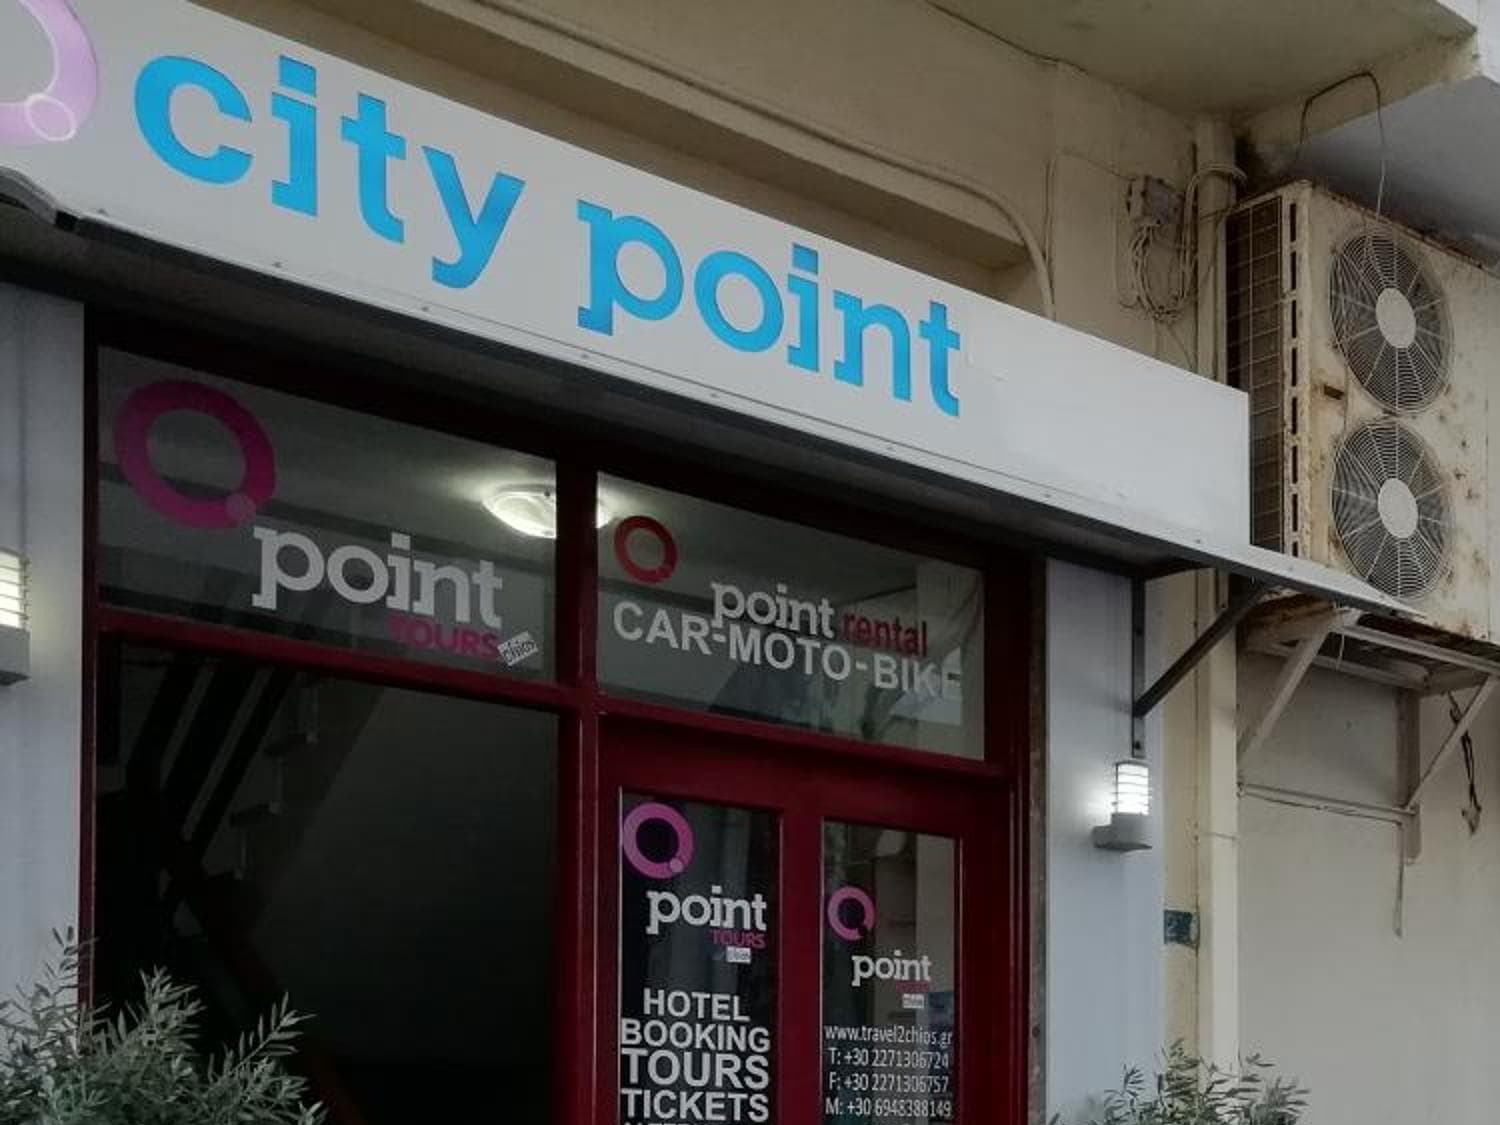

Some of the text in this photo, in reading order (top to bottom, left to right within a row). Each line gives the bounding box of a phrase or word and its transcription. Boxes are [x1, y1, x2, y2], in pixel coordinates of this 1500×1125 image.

[133, 54, 961, 416] city point
[251, 526, 503, 629] point
[386, 613, 498, 660] TOURS
[710, 582, 927, 656] point rental
[613, 601, 961, 700] CAR-MOTO-BIKE
[646, 885, 767, 934] point
[852, 950, 931, 987] point
[643, 988, 750, 1022] HOTEL
[621, 1018, 770, 1052] BOOKING
[825, 1025, 952, 1048] www.travel2chios.gr
[621, 1050, 769, 1089] TOURS
[829, 1048, 841, 1065] T:
[844, 1049, 869, 1066] +30
[829, 1072, 841, 1091] F:
[844, 1074, 869, 1091] +30
[621, 1089, 769, 1123] TICKETS
[825, 1098, 843, 1115] M:
[847, 1099, 871, 1115] +30
